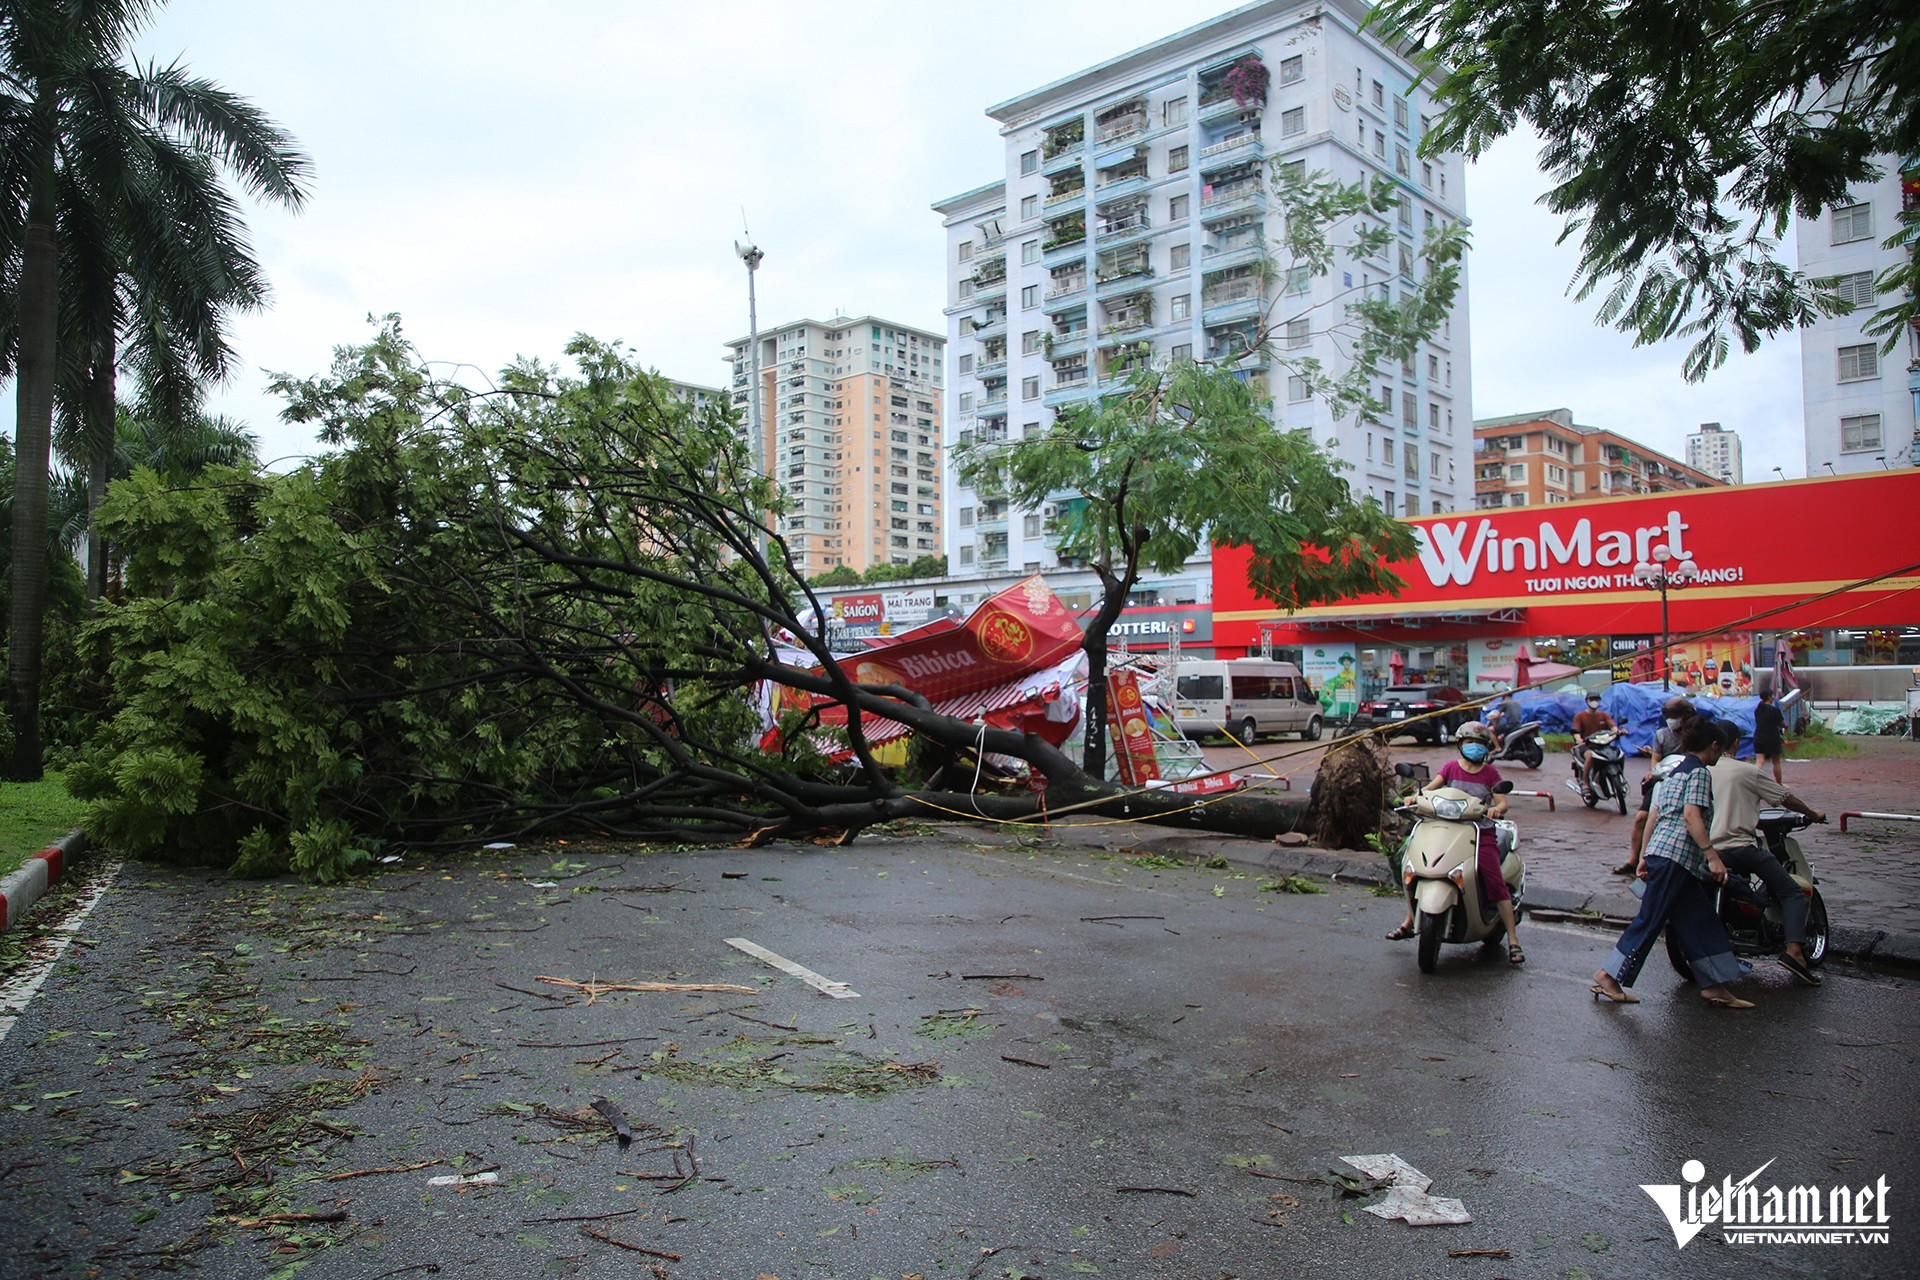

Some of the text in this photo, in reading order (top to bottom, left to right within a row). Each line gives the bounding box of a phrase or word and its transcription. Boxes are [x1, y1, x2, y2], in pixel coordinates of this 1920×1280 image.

[1408, 510, 1693, 587] WinMart
[1564, 574, 1611, 591] NGON
[887, 600, 902, 608] MAI
[904, 597, 932, 608] TRANG
[843, 604, 879, 618] SAIGON
[897, 648, 977, 679] Bibica
[1203, 777, 1224, 790] Bibica
